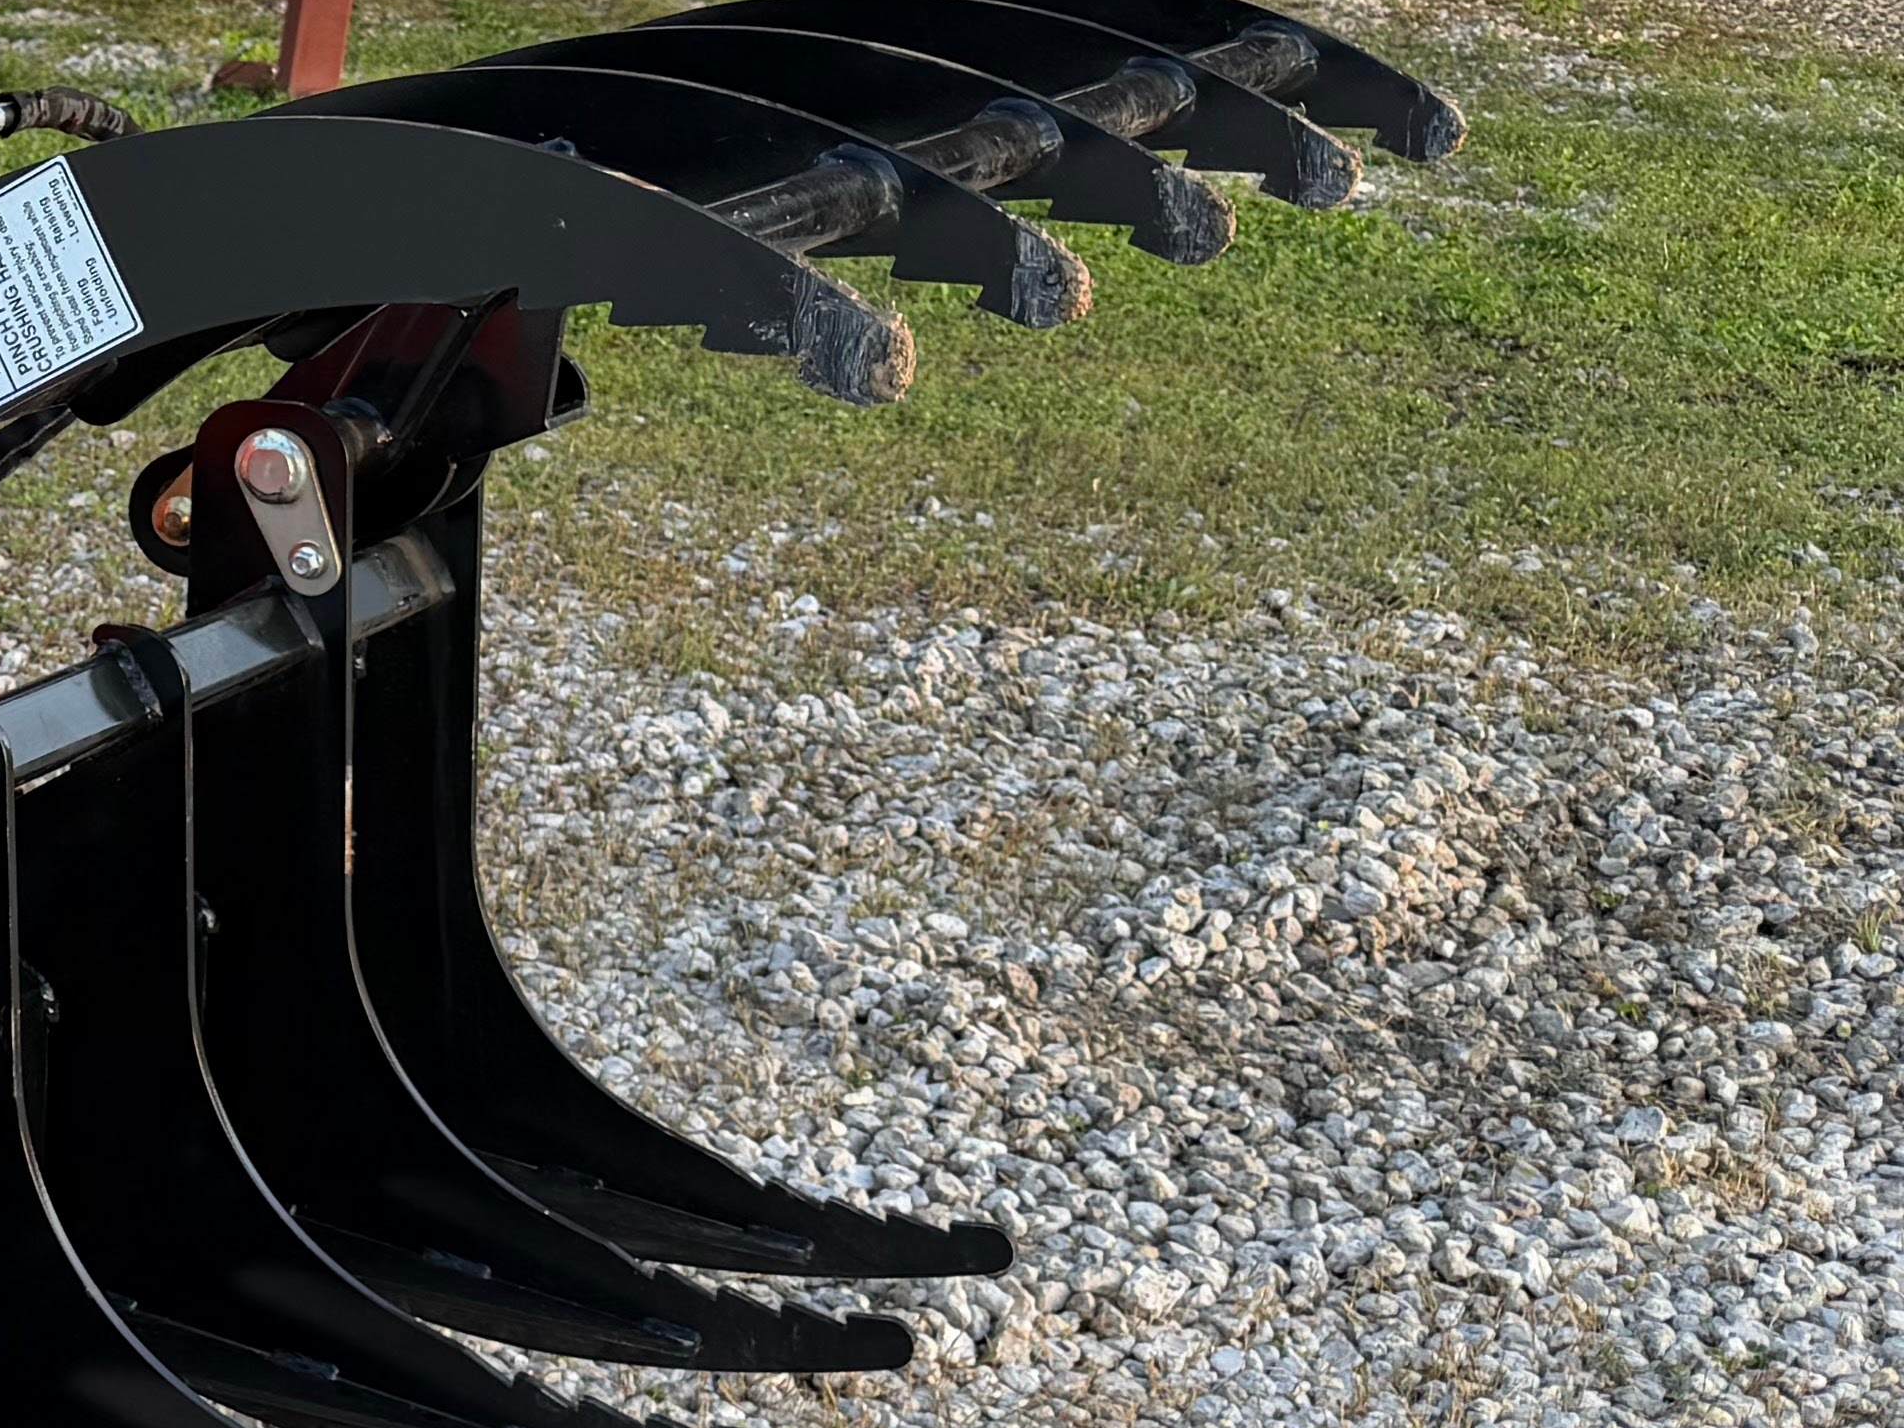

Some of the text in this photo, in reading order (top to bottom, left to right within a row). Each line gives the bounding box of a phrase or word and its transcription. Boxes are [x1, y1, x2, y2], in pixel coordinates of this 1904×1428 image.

[39, 195, 65, 244] Raising
[48, 177, 79, 237] Lowering
[76, 277, 103, 326] Folding
[84, 256, 117, 318] Unfolding
[3, 283, 52, 372] CRUSHING
